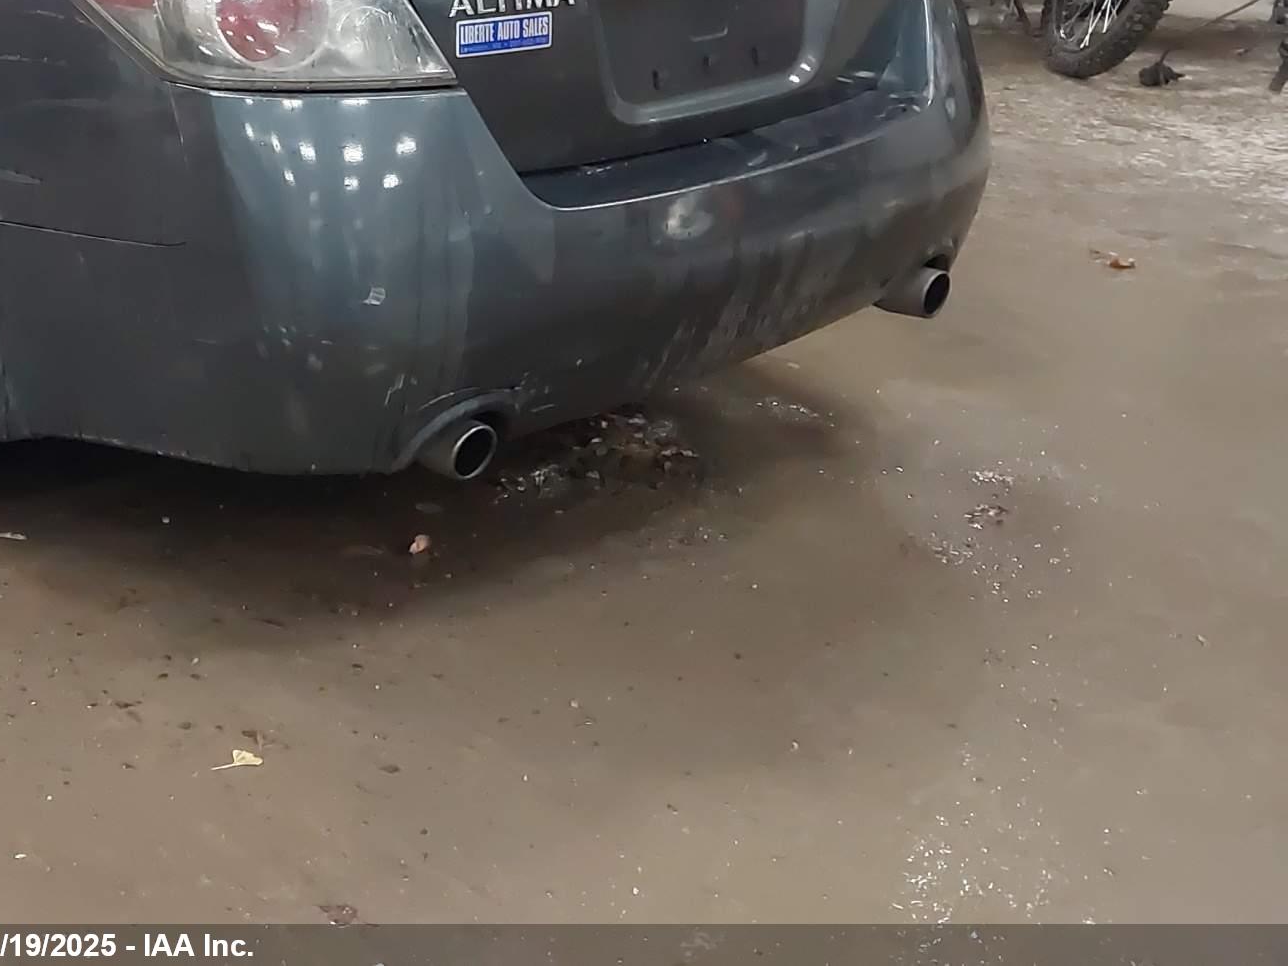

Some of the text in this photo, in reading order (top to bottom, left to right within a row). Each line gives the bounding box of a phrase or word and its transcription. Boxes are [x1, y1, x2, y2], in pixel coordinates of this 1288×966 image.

[460, 24, 495, 45] LIBERTE
[497, 20, 520, 40] AUTO
[522, 17, 549, 38] SALES
